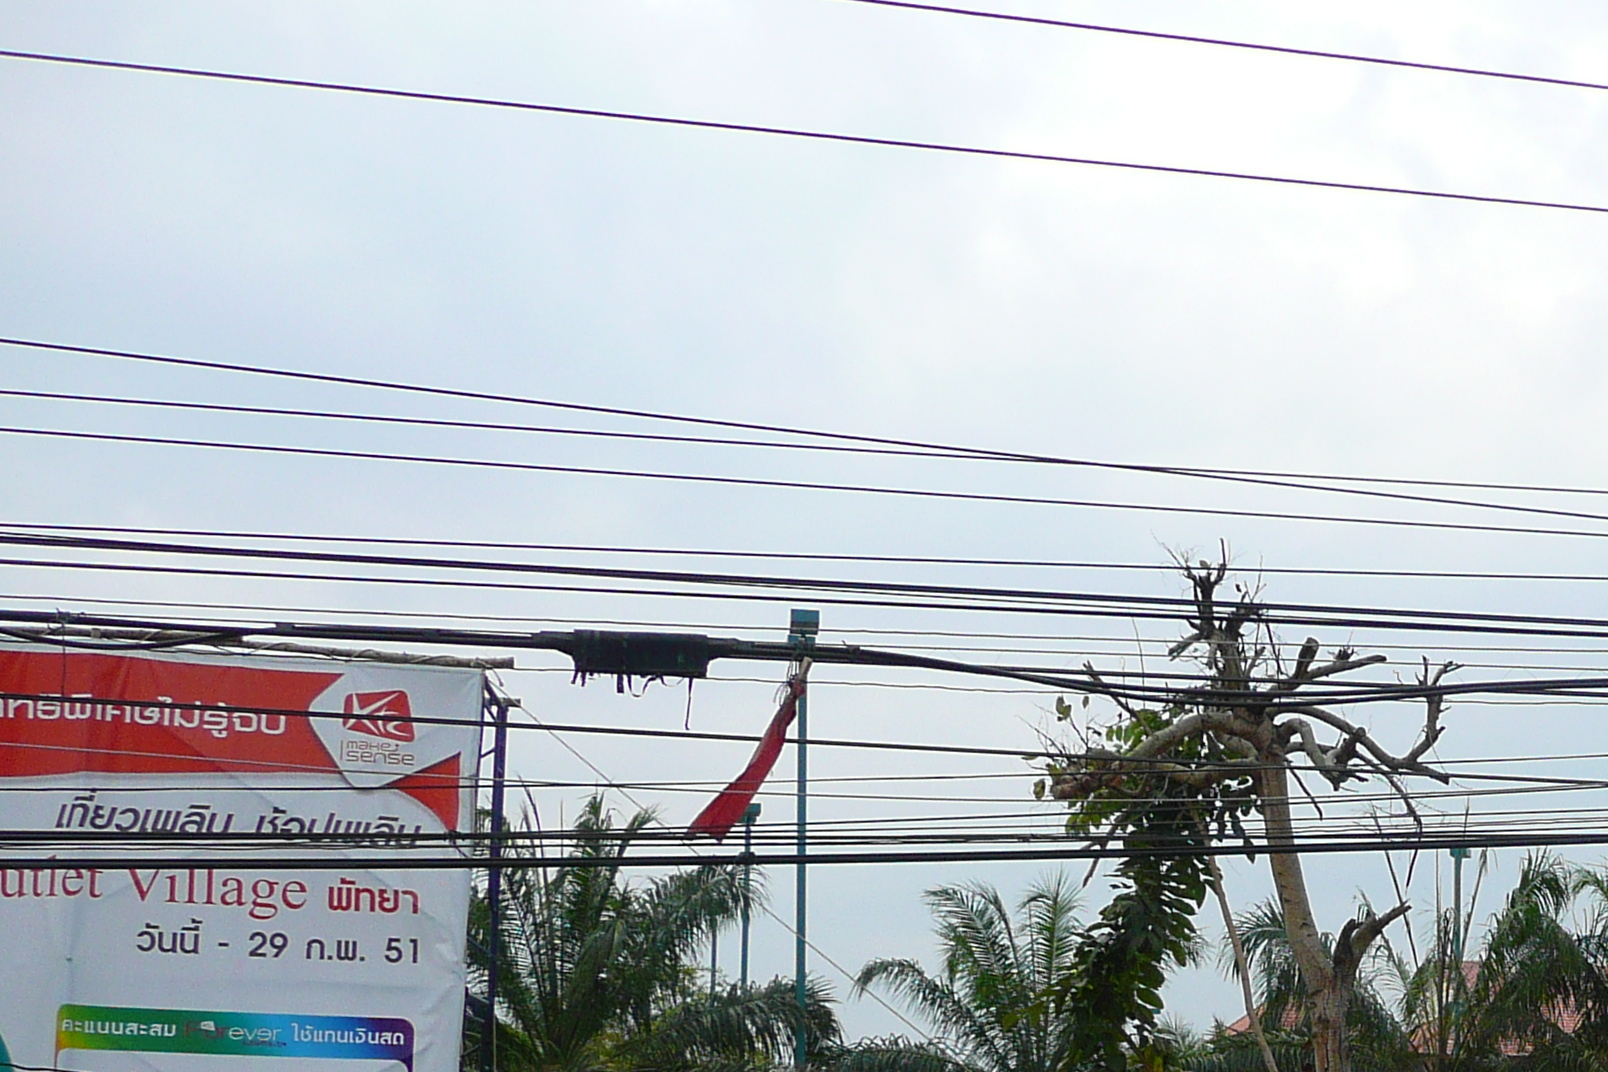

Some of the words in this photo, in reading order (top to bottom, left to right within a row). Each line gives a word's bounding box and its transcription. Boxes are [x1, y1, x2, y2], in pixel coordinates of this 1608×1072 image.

[0, 690, 287, 738] ทธิพิเศษไม่รู้จบ
[346, 750, 415, 766] sense
[0, 855, 103, 899] utlet
[128, 862, 308, 920] Village
[328, 876, 420, 915] พัทยา
[136, 917, 203, 955] วันนี้
[248, 931, 289, 959] 29
[305, 938, 366, 963] ก.พ.
[384, 936, 420, 964] 51
[62, 1017, 177, 1038] คะแนนสะสม
[291, 1022, 405, 1046] ใช้แทนเงินสด
